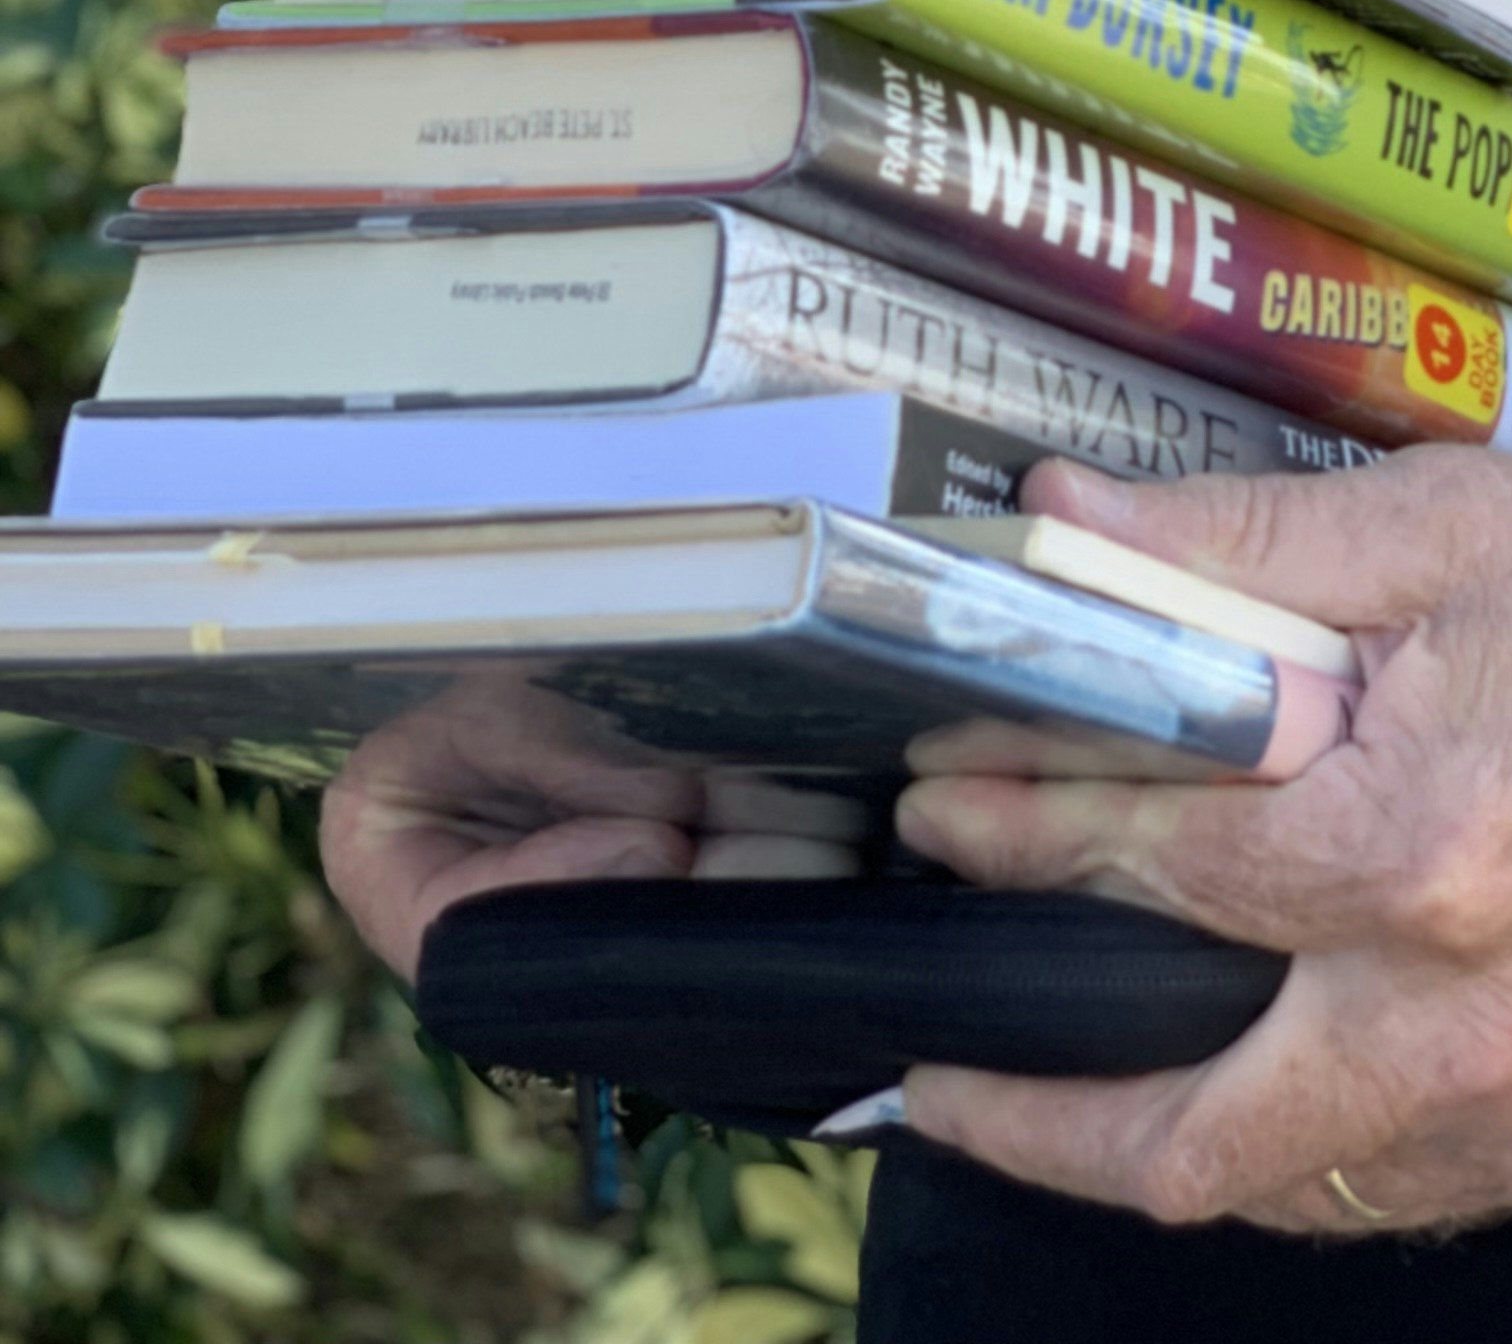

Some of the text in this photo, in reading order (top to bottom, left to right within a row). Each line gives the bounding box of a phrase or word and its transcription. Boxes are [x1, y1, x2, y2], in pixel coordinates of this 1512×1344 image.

[877, 56, 913, 188] RANDY
[914, 72, 949, 197] WAYNE
[1380, 79, 1443, 182] THE
[956, 89, 1411, 351] WHITE CARIBB
[781, 264, 1239, 478] RUTH WARE
[1430, 321, 1453, 369] 14
[1468, 334, 1486, 390] DAY
[1479, 327, 1499, 409] BOOK
[1278, 423, 1338, 469] THE
